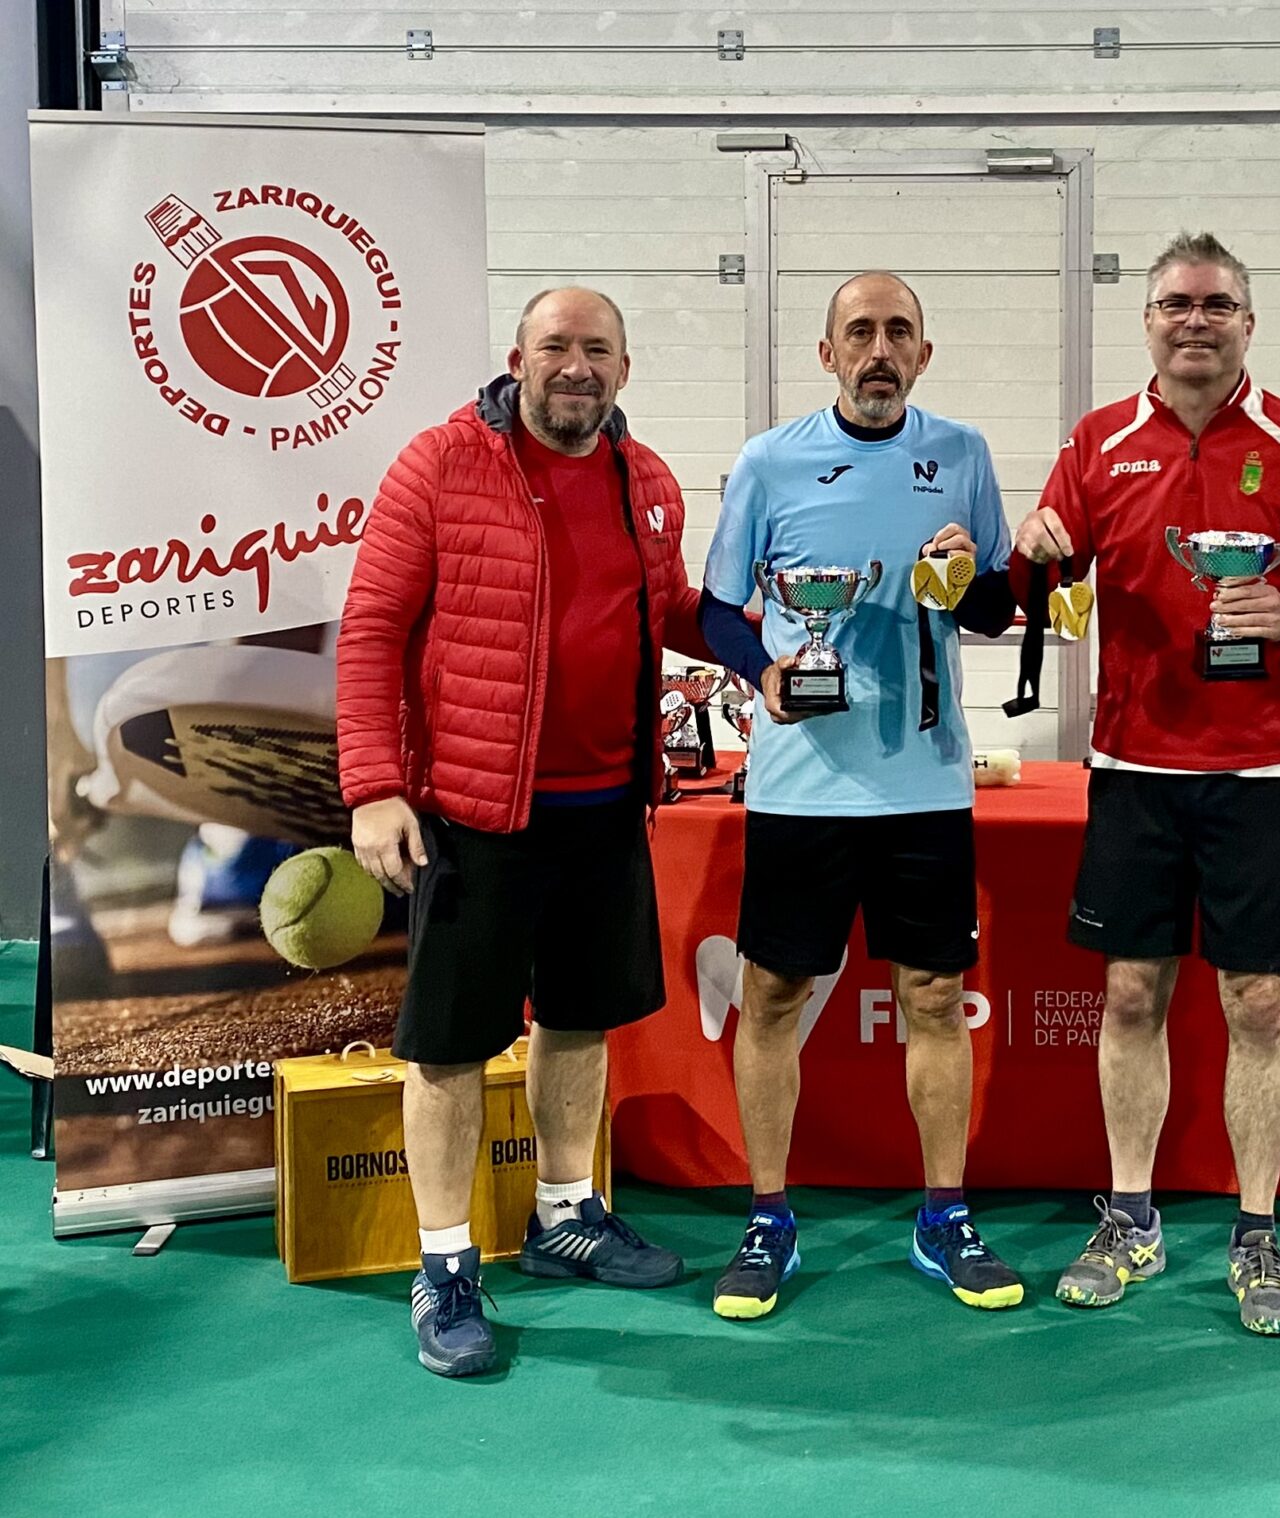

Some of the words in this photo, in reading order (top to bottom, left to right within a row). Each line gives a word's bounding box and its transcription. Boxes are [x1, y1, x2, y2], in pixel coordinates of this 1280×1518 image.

[213, 185, 401, 308] ZARIQUIEGUI
[129, 262, 229, 437] DEPORTES
[271, 340, 401, 450] PAMPLONA
[77, 590, 236, 628] DEPORTES
[1035, 1029, 1059, 1047] DE
